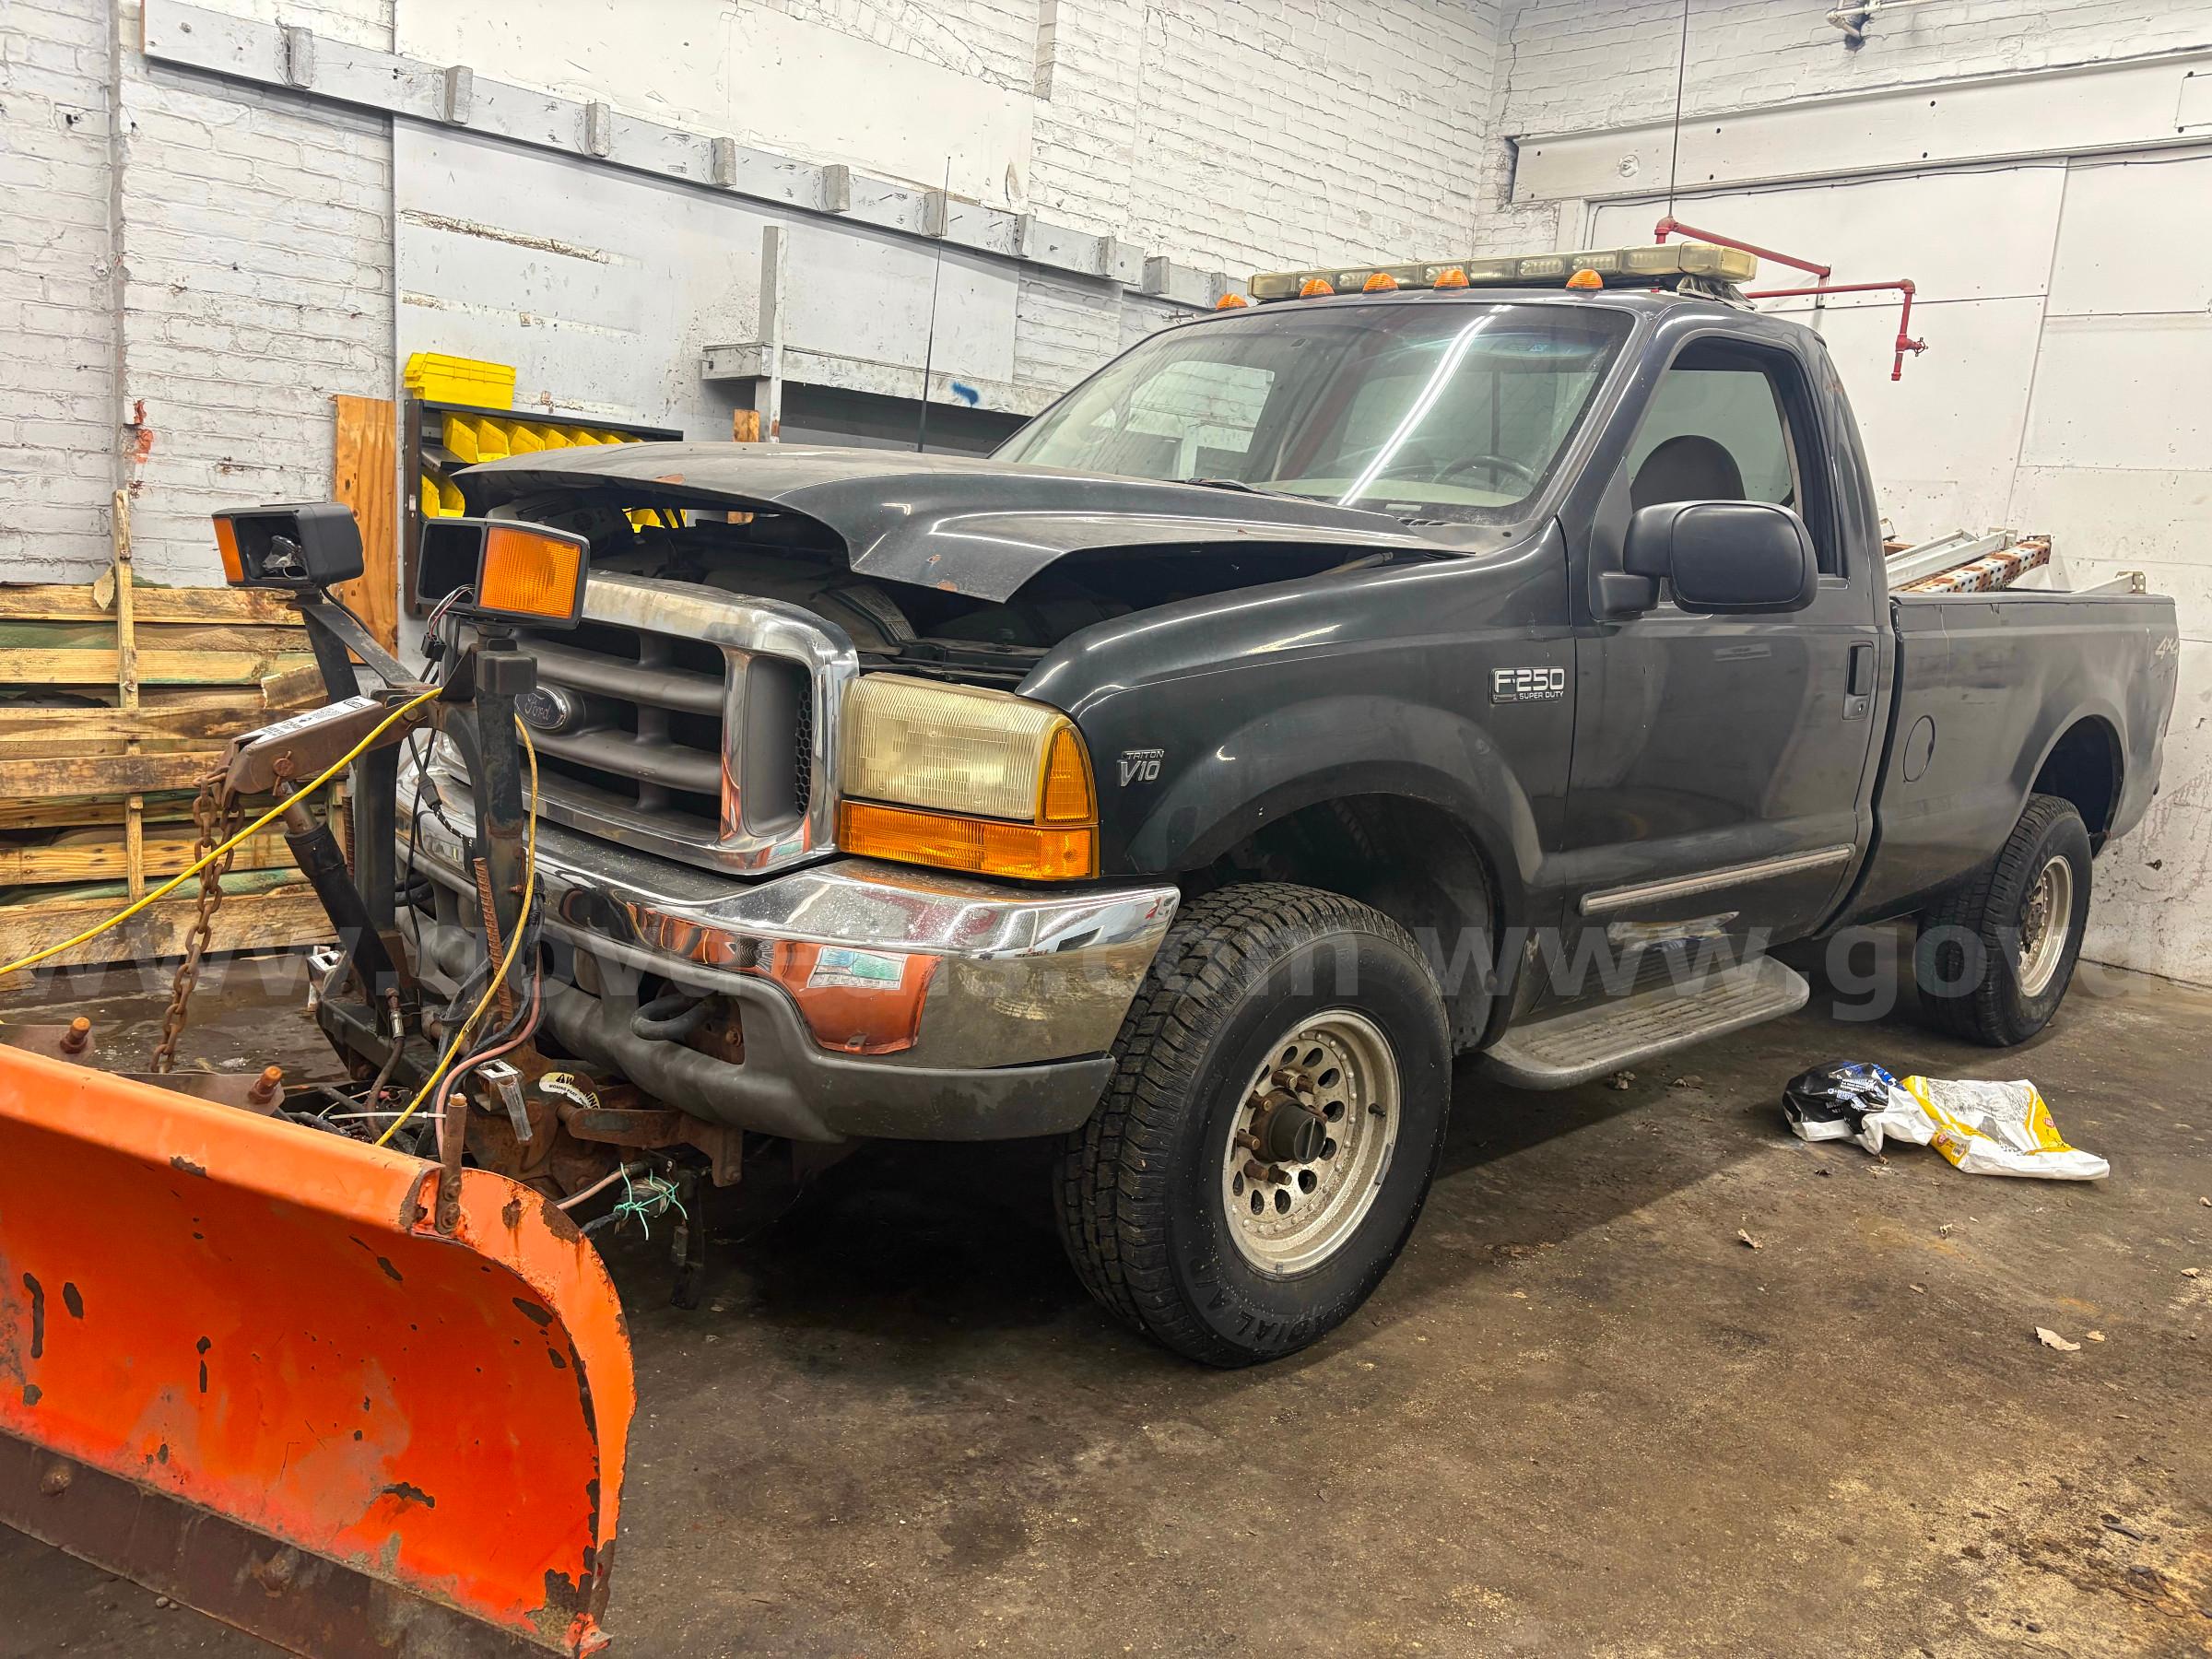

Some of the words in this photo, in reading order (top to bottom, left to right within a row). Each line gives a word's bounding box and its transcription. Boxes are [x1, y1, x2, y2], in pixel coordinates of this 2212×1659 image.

[1519, 691, 1544, 700] SUPER
[1545, 690, 1565, 699] DUTY
[524, 693, 552, 721] Ford
[1126, 750, 1165, 760] TRITON
[1120, 760, 1161, 787] V10
